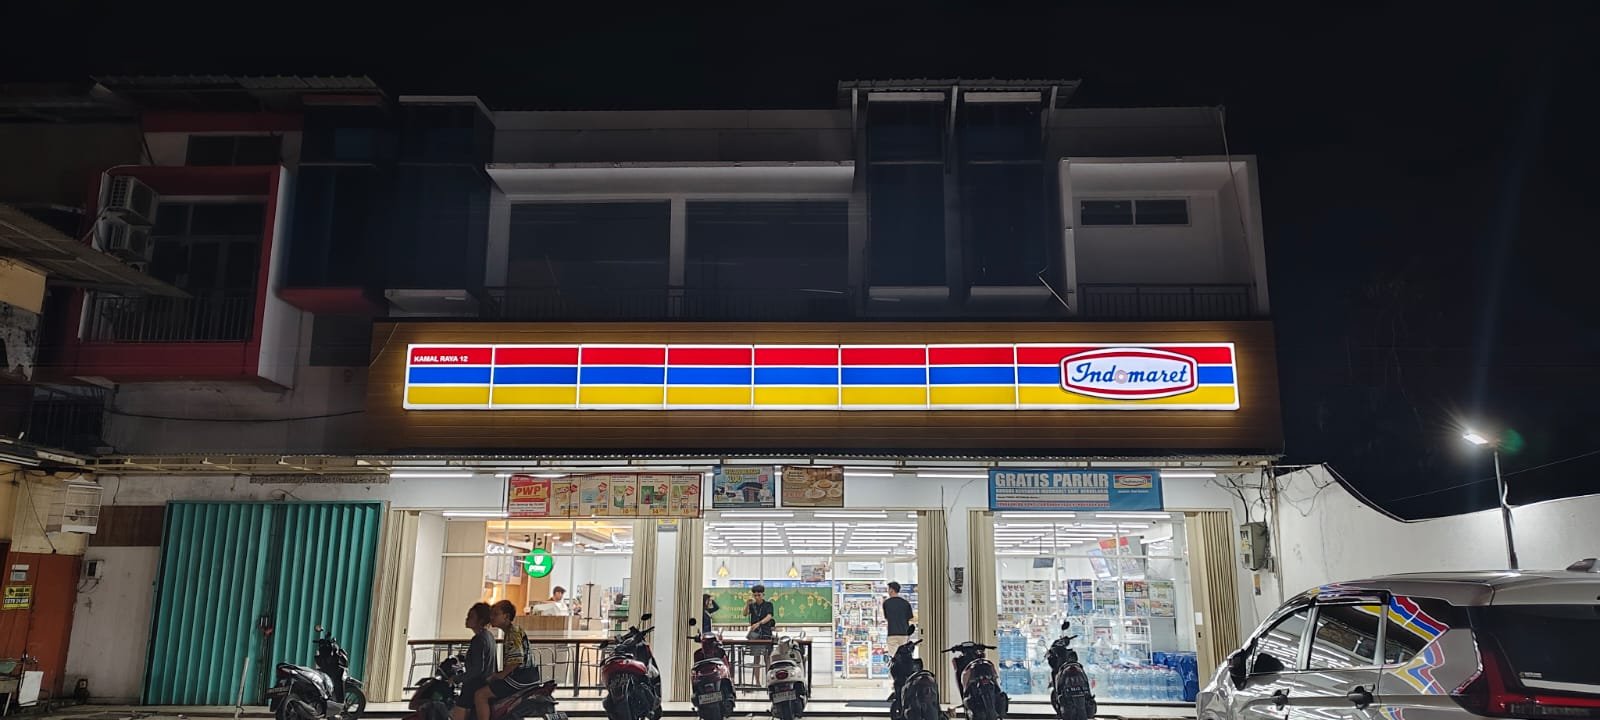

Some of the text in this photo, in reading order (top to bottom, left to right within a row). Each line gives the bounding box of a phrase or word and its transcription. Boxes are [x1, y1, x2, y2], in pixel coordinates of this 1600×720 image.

[414, 355, 469, 363] KAMAL RAYA 12
[1071, 362, 1188, 384] Indomaret
[995, 473, 1109, 488] GRATIS PARKIR
[515, 486, 541, 496] PWP
